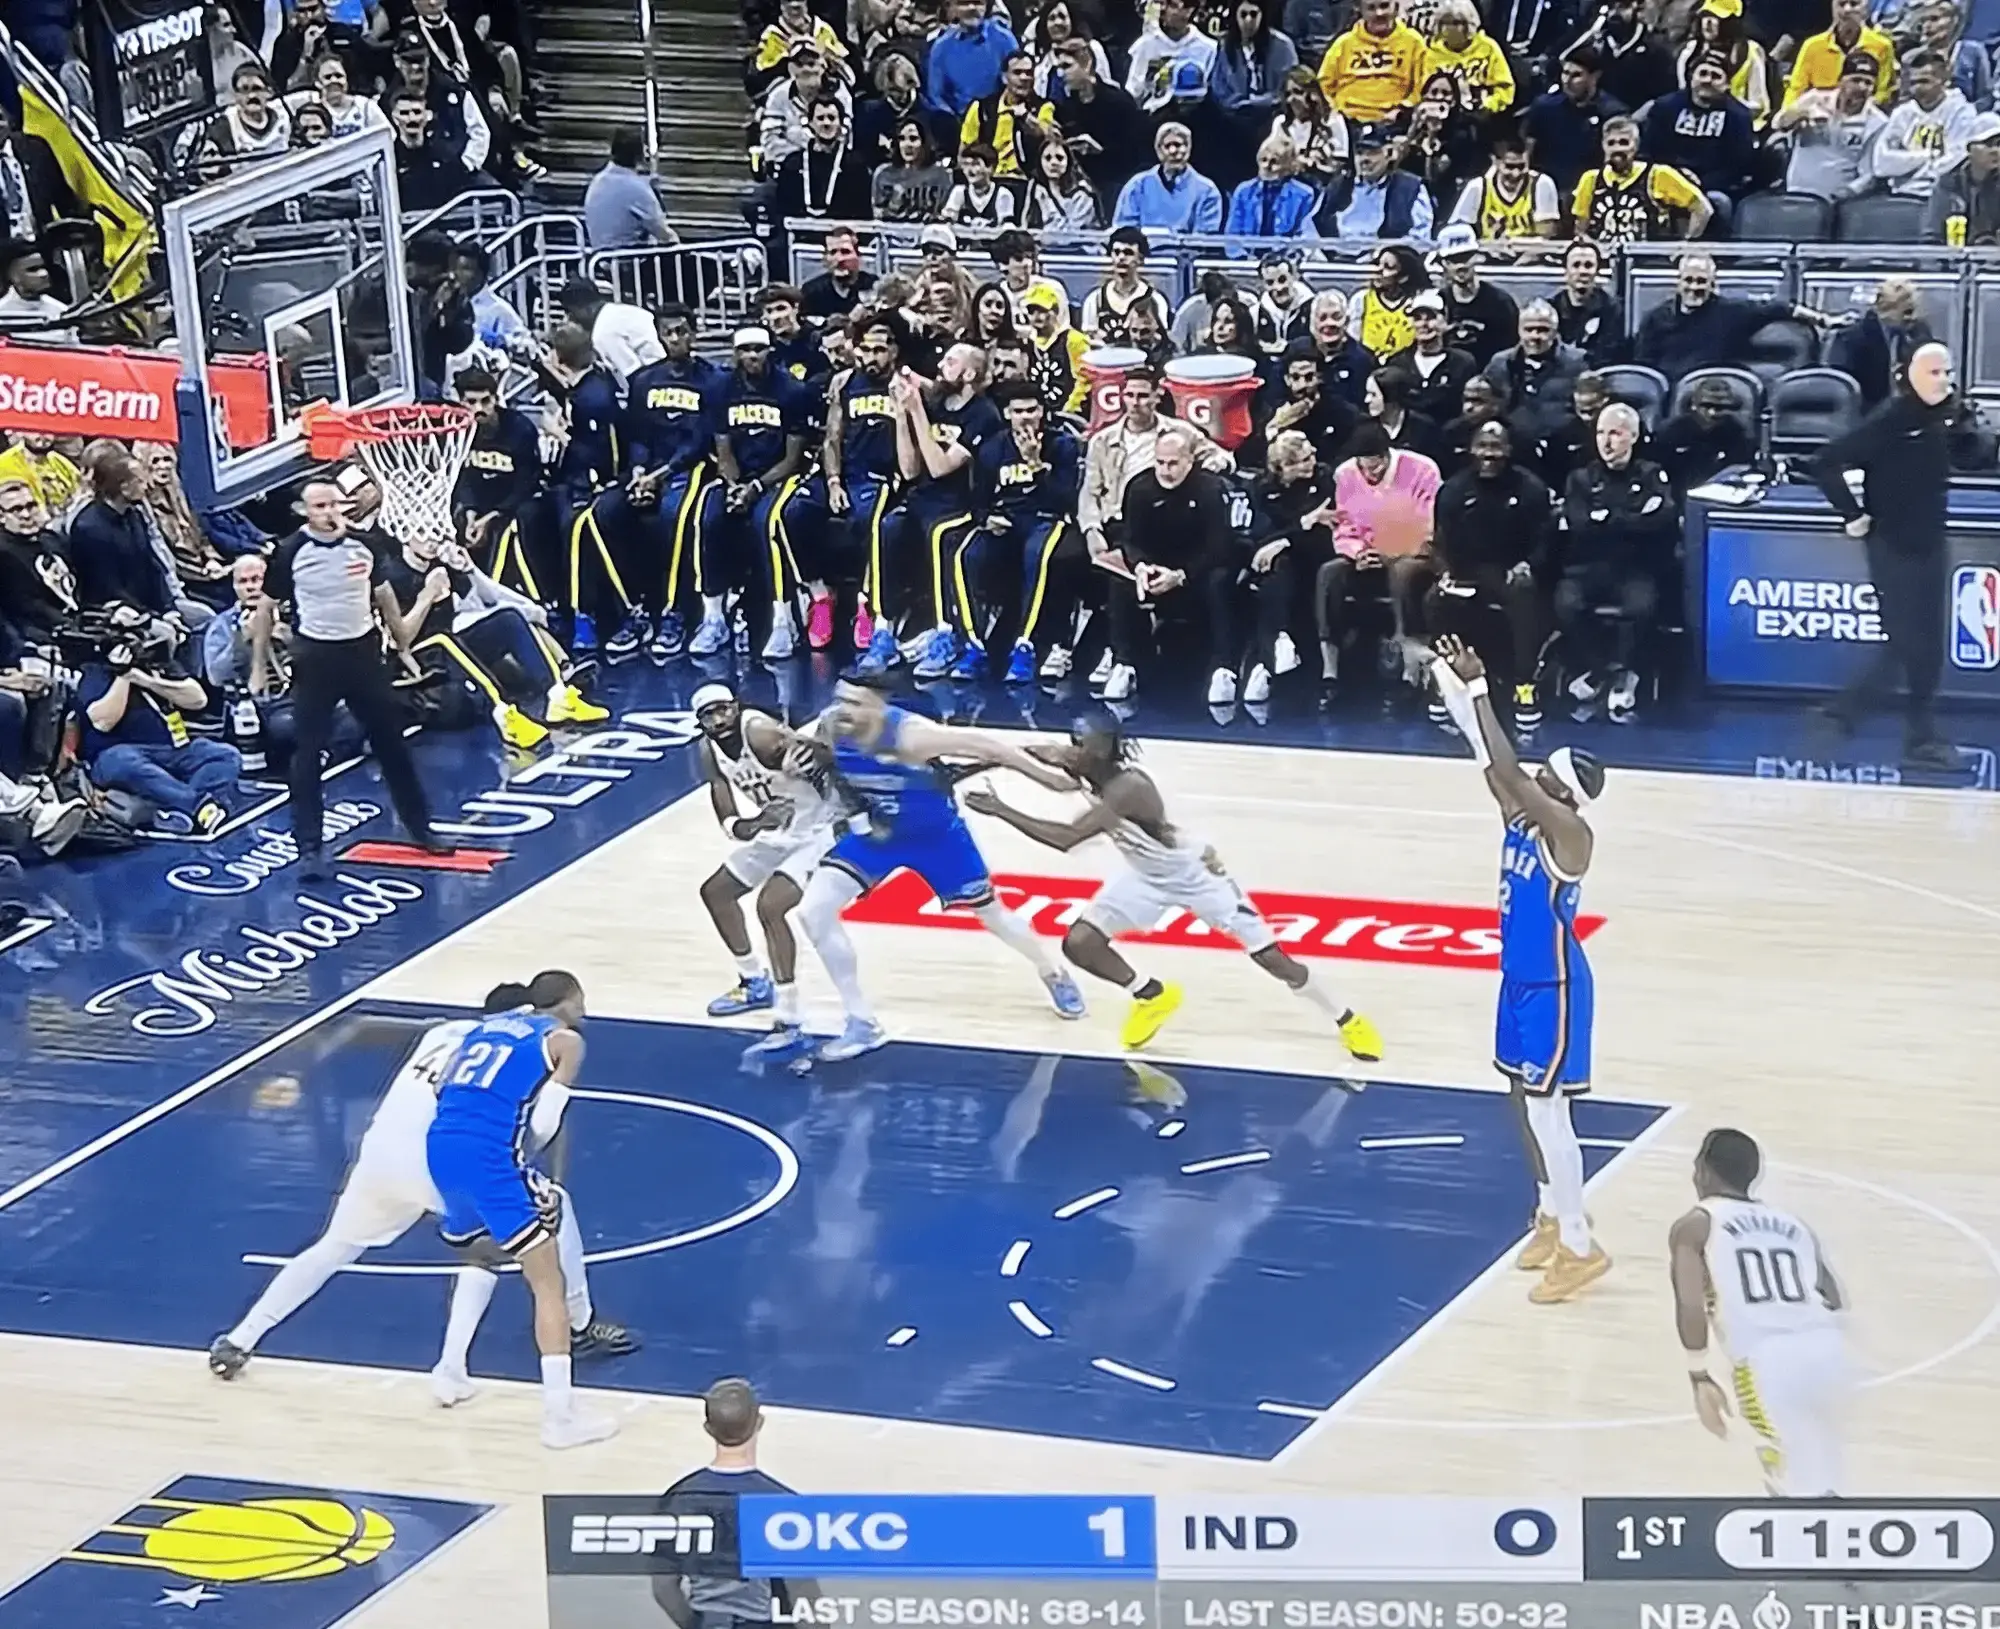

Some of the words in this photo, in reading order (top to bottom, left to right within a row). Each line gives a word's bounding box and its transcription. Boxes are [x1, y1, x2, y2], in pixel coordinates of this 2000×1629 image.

[137, 6, 204, 55] TISSOT
[1097, 385, 1121, 412] G
[1187, 398, 1211, 425] G
[1728, 578, 1880, 612] AMERIC
[1756, 611, 1890, 641] EXPRE
[428, 710, 704, 835] ULTRA
[84, 872, 424, 1036] Michelob
[453, 1041, 514, 1089] 21
[1735, 1247, 1806, 1304] 00
